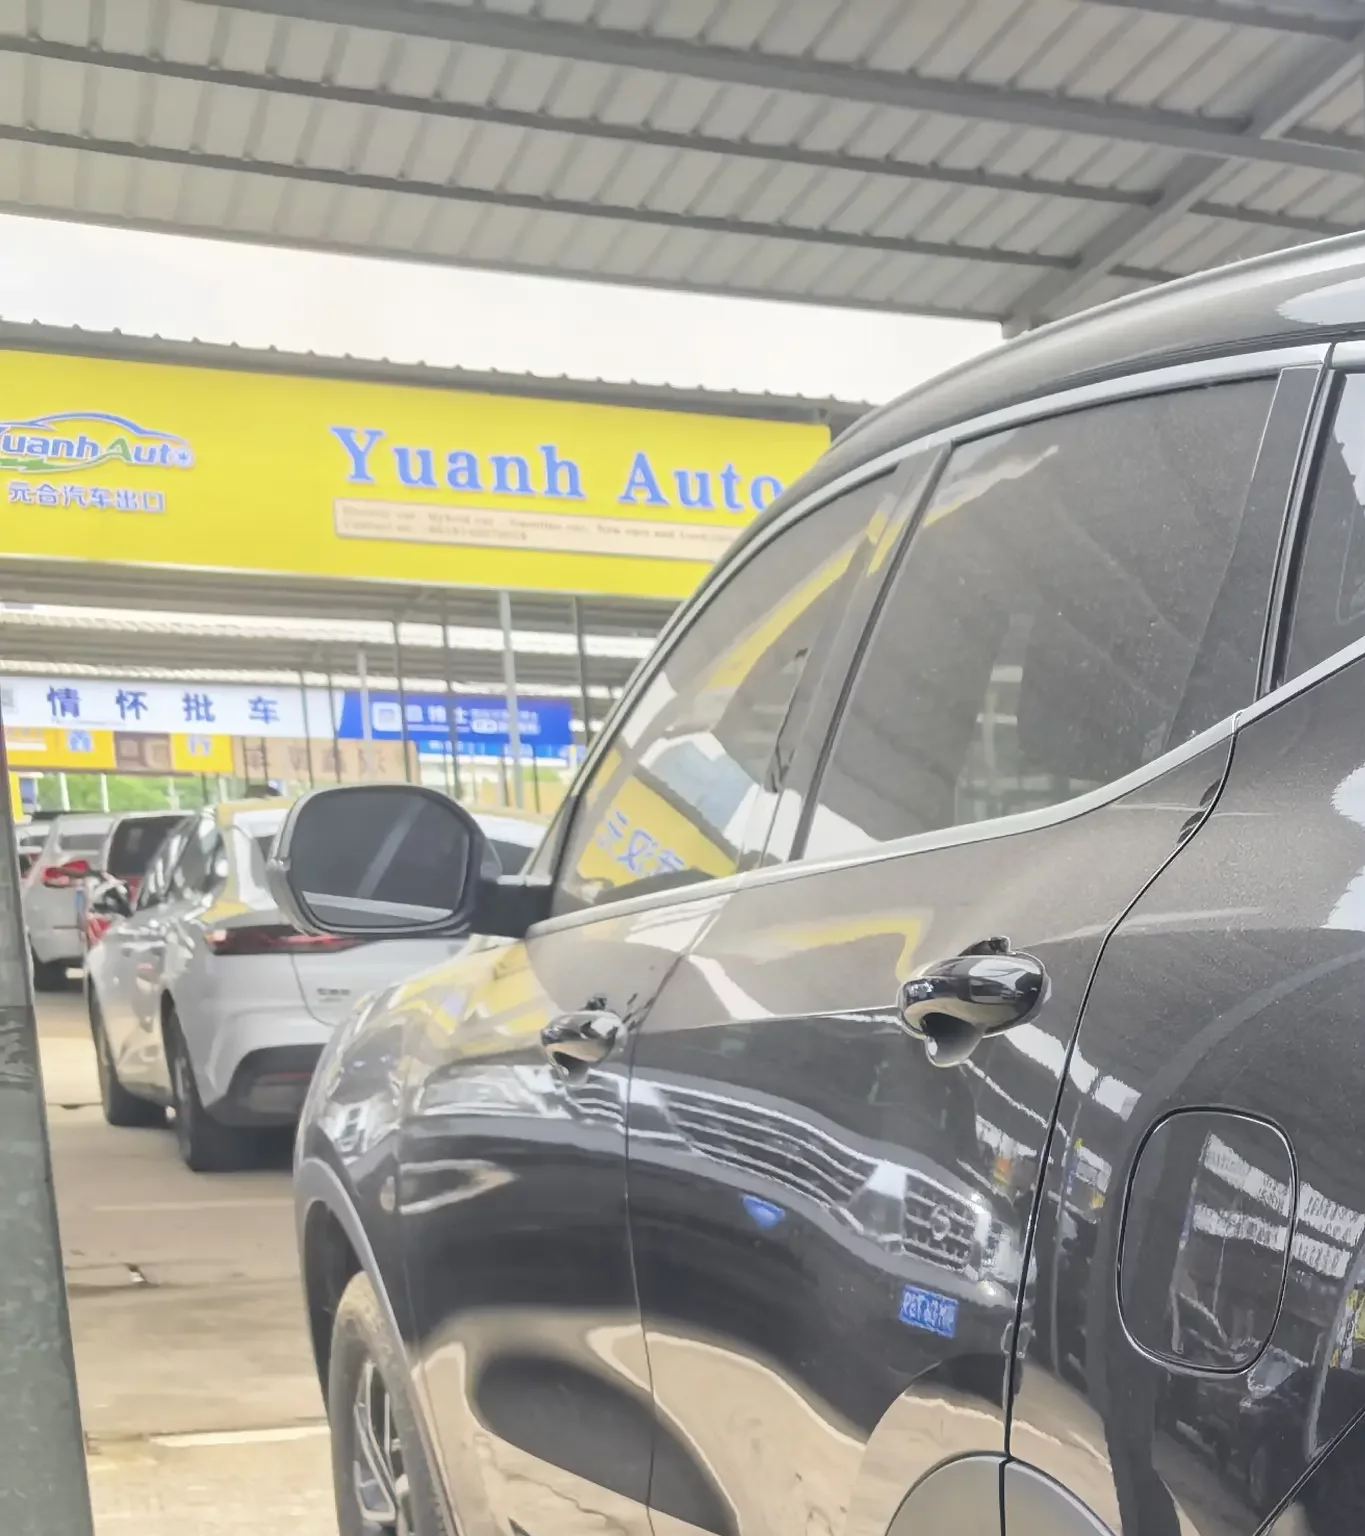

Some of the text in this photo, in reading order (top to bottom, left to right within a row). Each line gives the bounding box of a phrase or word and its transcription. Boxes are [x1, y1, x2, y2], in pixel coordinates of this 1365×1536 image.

[330, 425, 787, 513] Yuanh Auto
[9, 482, 165, 513] 元合汽车出口
[47, 684, 280, 725] 情怀批车
